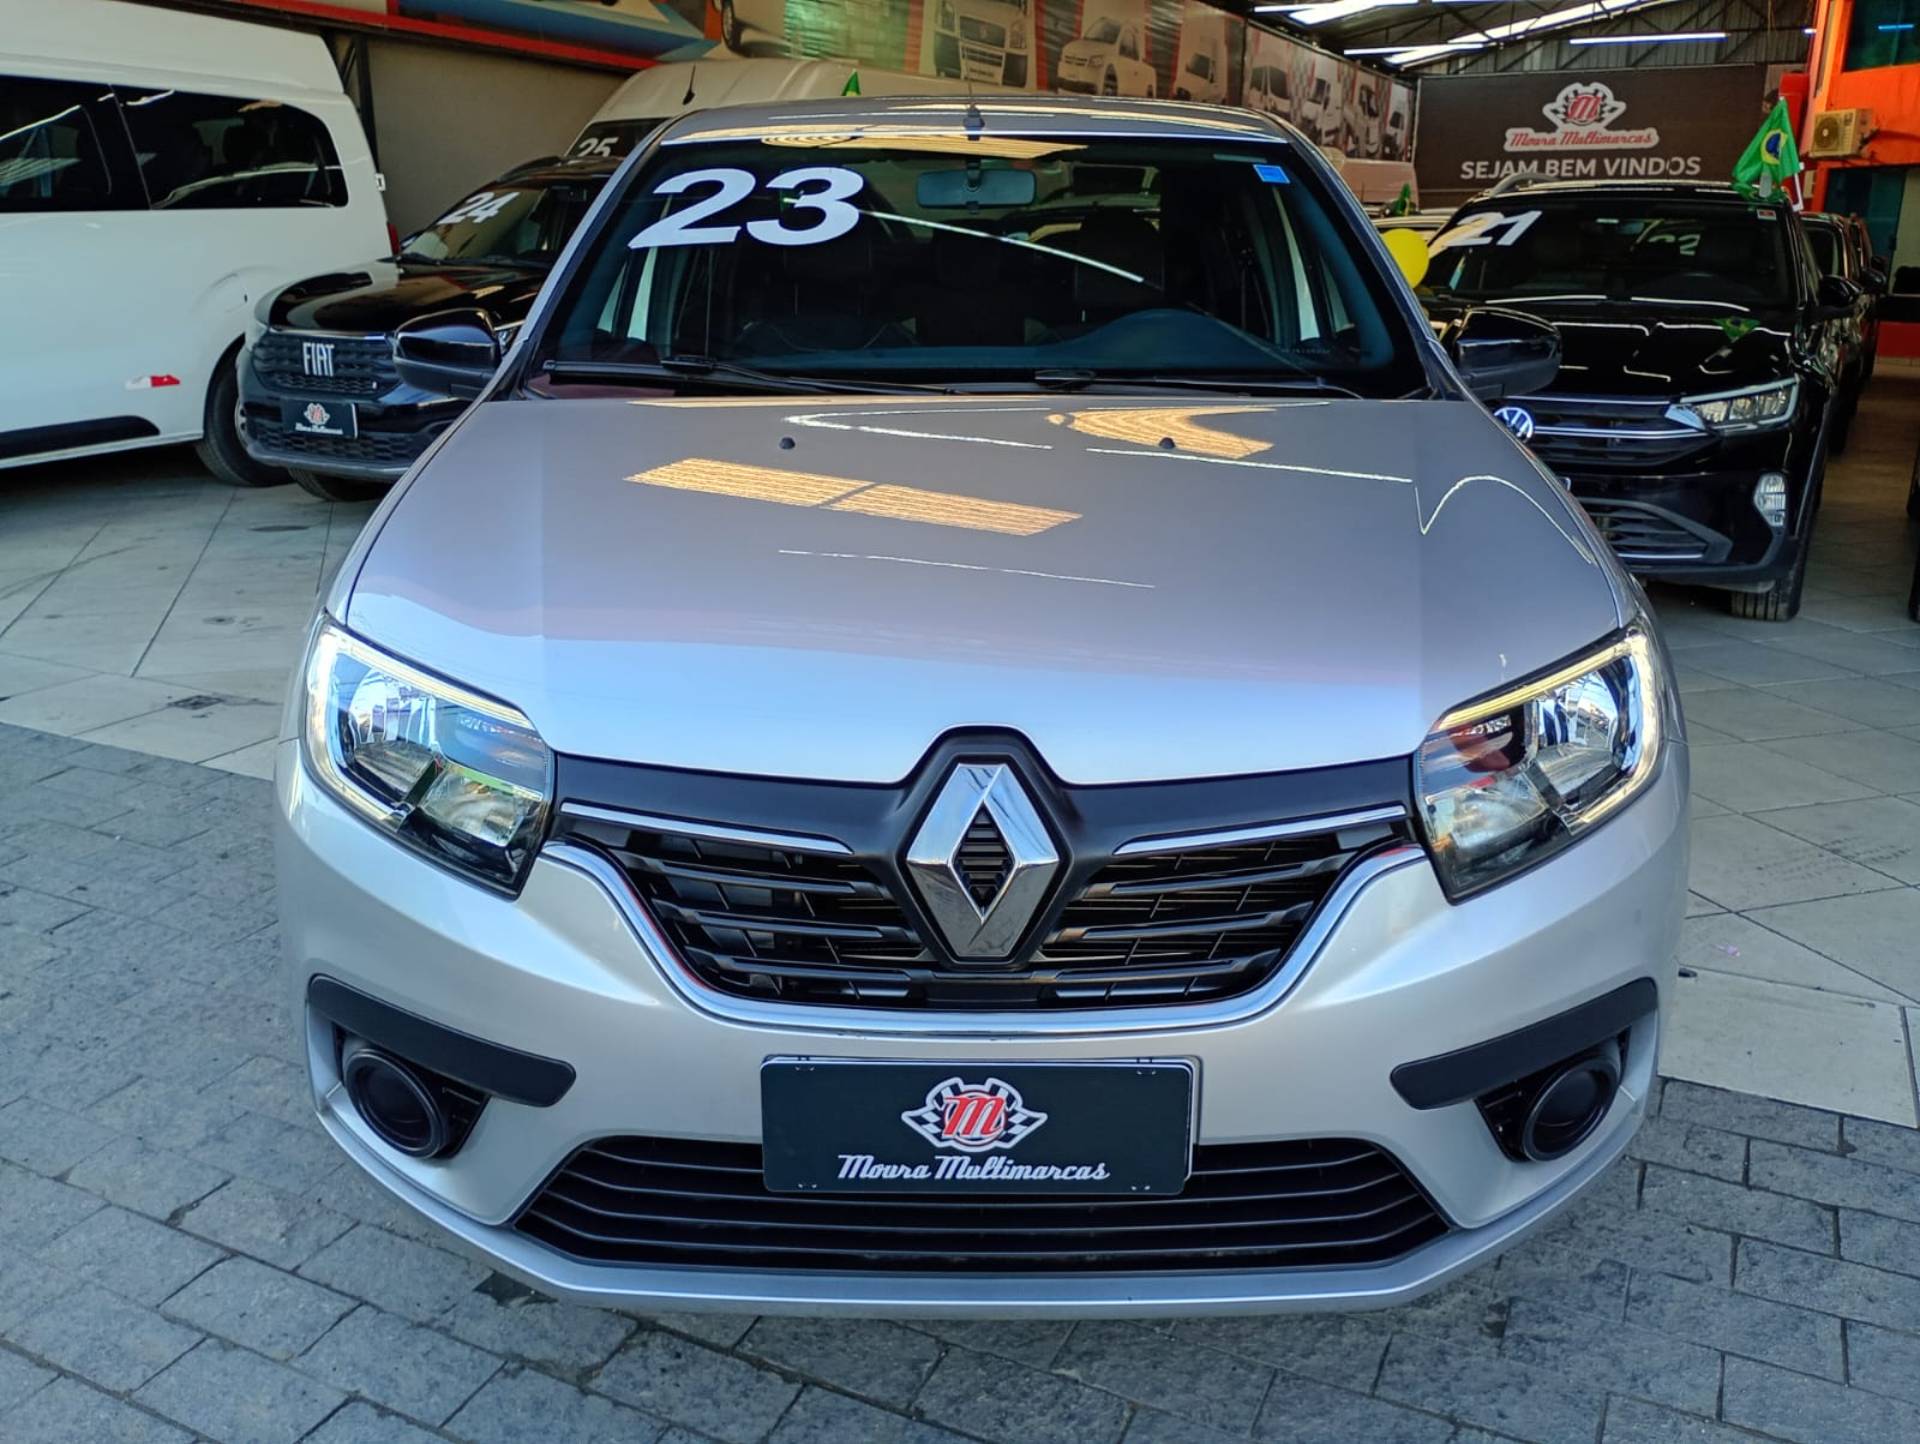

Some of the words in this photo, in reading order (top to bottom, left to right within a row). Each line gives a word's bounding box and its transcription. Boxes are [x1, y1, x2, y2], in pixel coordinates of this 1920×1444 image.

[578, 137, 619, 157] 25
[1460, 159, 1539, 179] SEJAM
[1544, 158, 1597, 177] BEM
[1603, 156, 1702, 177] VINDOS
[436, 192, 520, 224] 24
[627, 166, 864, 249] 23
[1440, 210, 1543, 247] 21
[302, 342, 335, 377] FIAT
[837, 1154, 932, 1180] Moura
[934, 1155, 1111, 1180] Multimarcas
